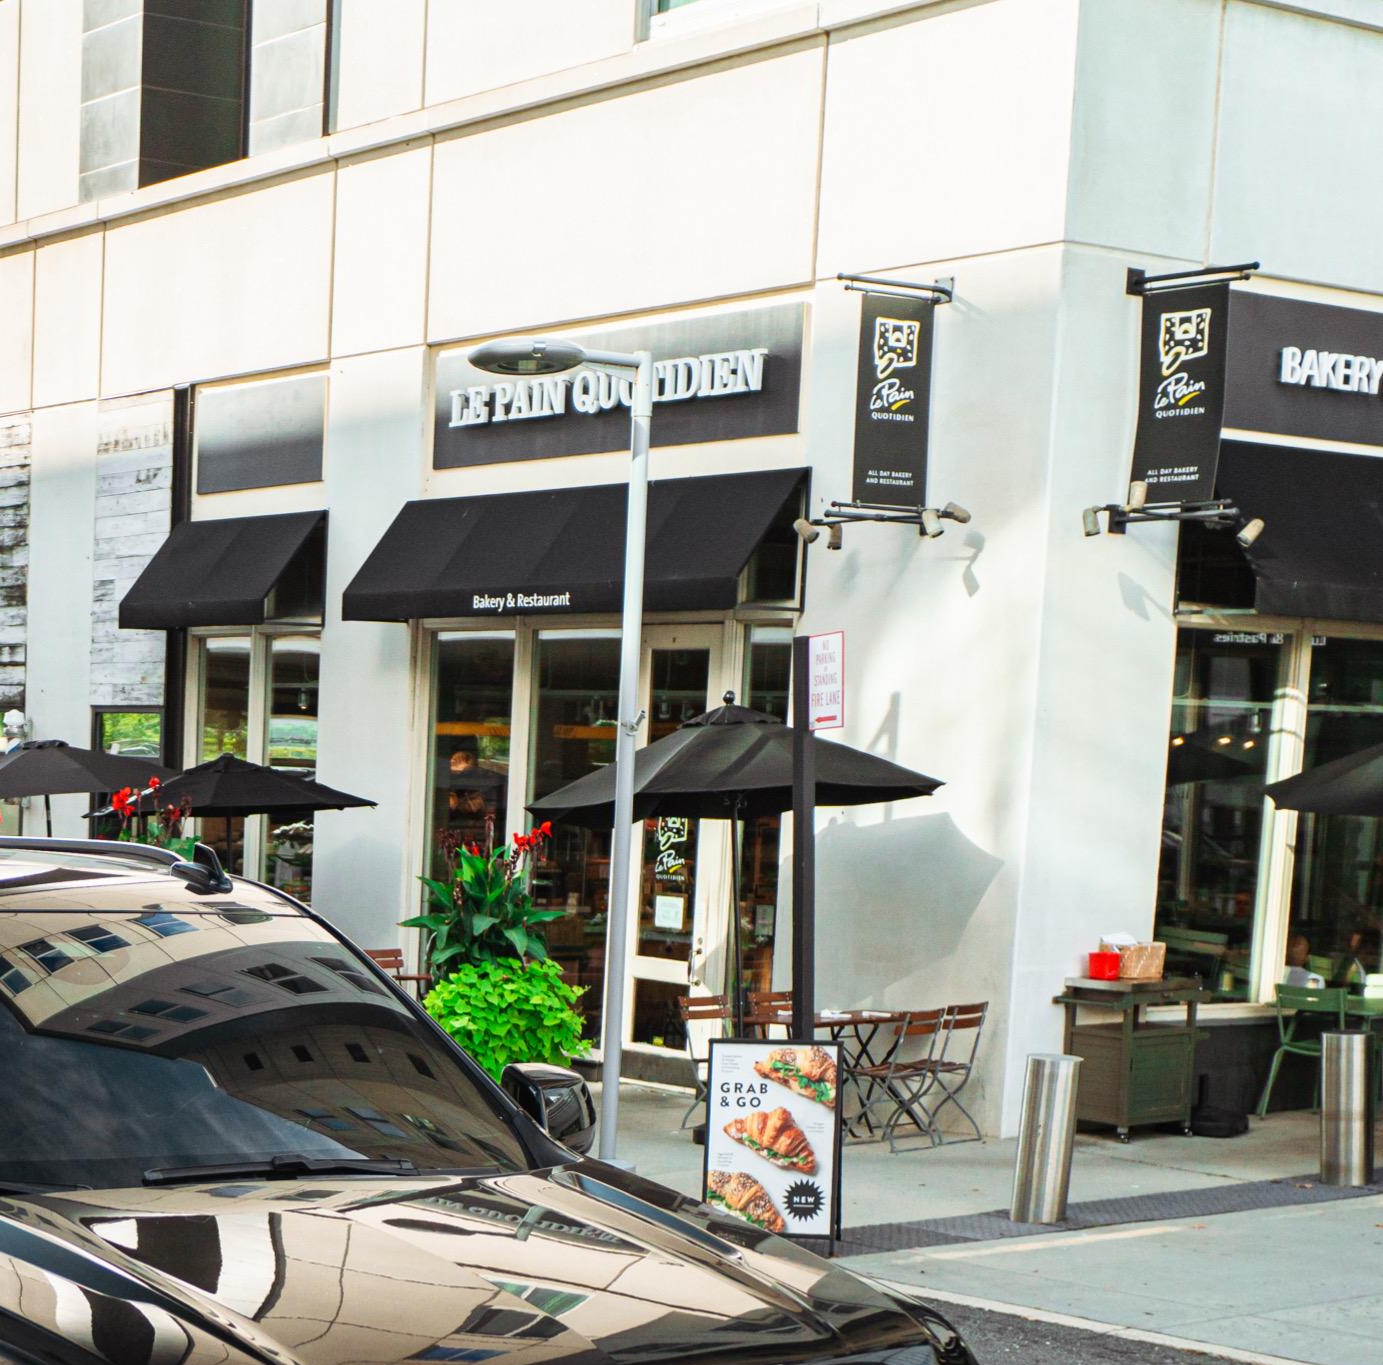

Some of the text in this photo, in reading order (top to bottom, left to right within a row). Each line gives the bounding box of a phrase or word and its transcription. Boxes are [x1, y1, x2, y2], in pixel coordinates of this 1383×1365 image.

[1281, 347, 1383, 395] BAKERY
[873, 378, 914, 407] Pain
[1157, 372, 1205, 403] Pain
[449, 388, 489, 428] LE
[493, 377, 573, 421] PAIN
[1156, 407, 1205, 418] QUOTIDIEN
[871, 411, 914, 422] QUOTIDIEN
[473, 592, 571, 612] Bakery & Restaurant
[657, 850, 686, 871] Pain
[720, 1082, 768, 1094] GRAB
[720, 1097, 761, 1107] & GO
[793, 1196, 815, 1204] NEW
